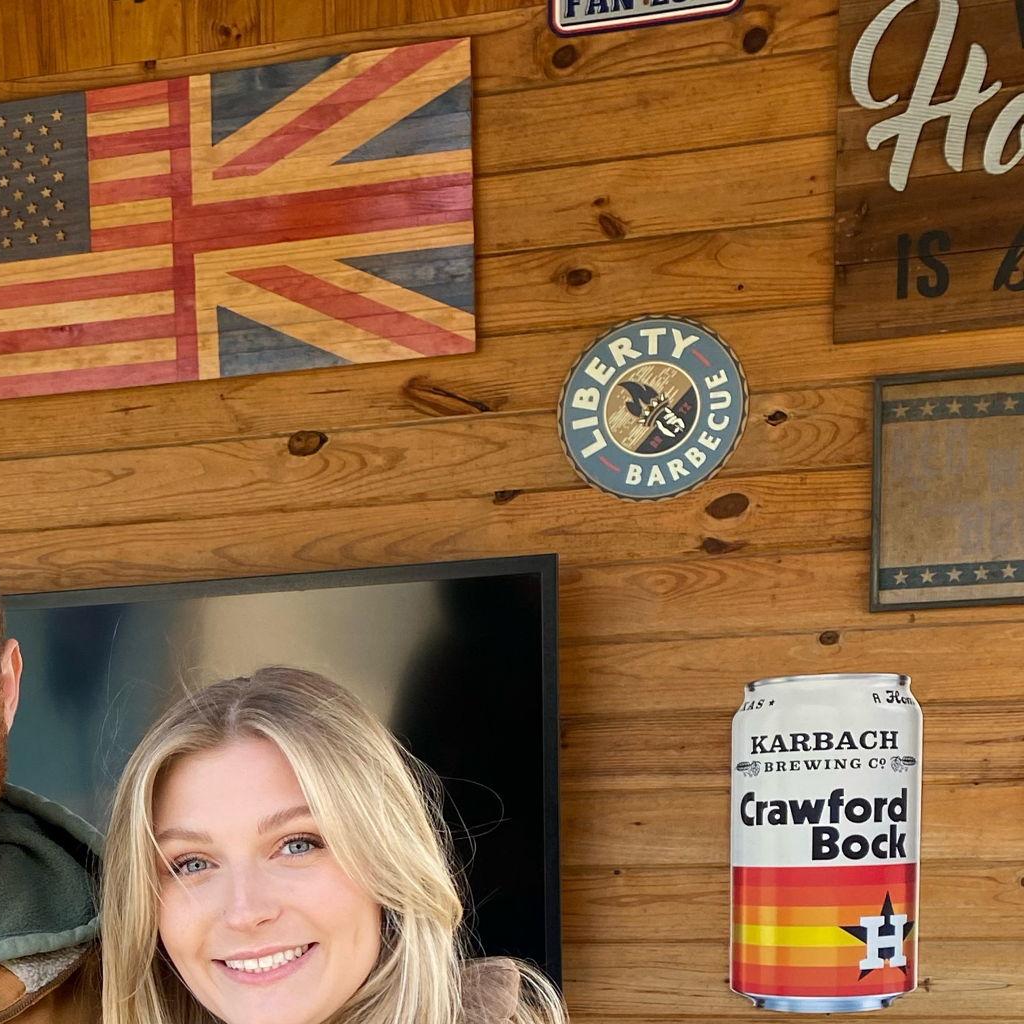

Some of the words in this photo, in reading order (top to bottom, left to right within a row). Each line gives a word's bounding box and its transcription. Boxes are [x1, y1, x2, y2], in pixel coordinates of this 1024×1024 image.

[896, 229, 951, 300] IS
[571, 327, 700, 459] LIBERTY
[625, 369, 732, 487] BARBECUE
[750, 730, 899, 755] KARBACH
[764, 758, 862, 773] BREWING
[740, 788, 908, 827] Crawford
[812, 824, 907, 861] Bock
